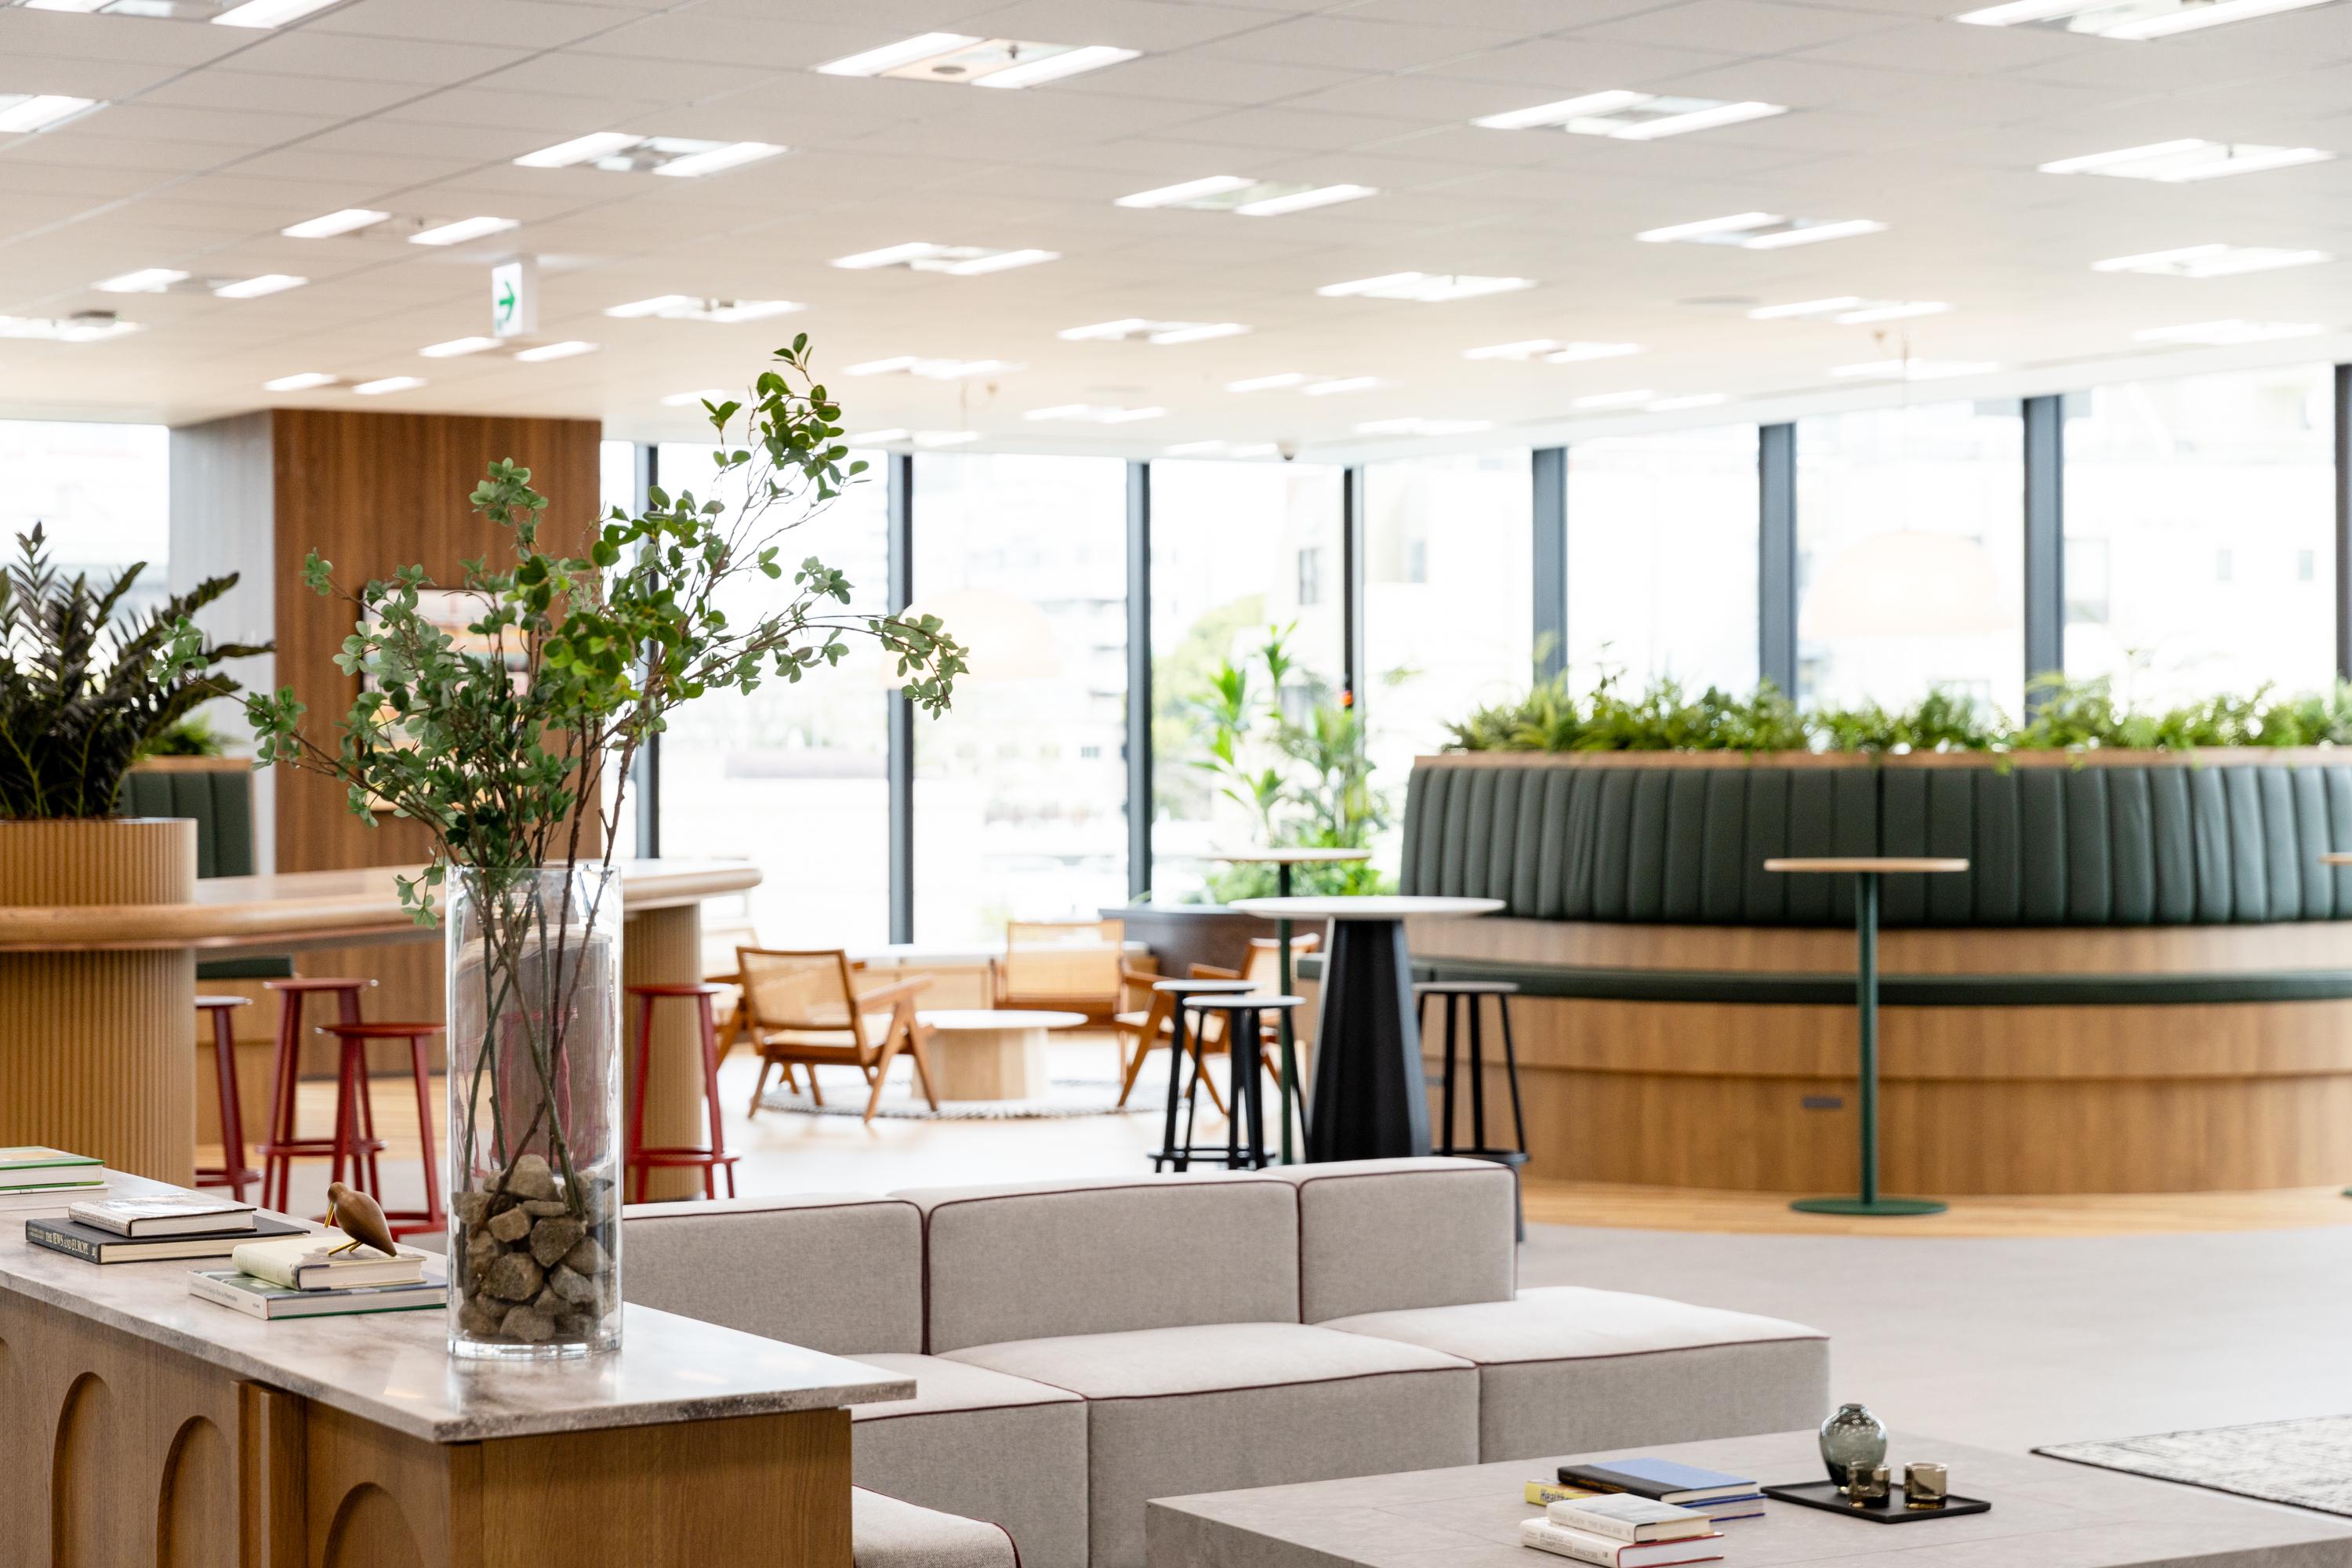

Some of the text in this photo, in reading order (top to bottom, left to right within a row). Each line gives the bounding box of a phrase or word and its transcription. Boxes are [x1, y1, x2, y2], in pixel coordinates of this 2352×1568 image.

[53, 1232, 63, 1247] JEWS
[63, 1238, 71, 1250] AND
[71, 1239, 89, 1254] EUROPE
